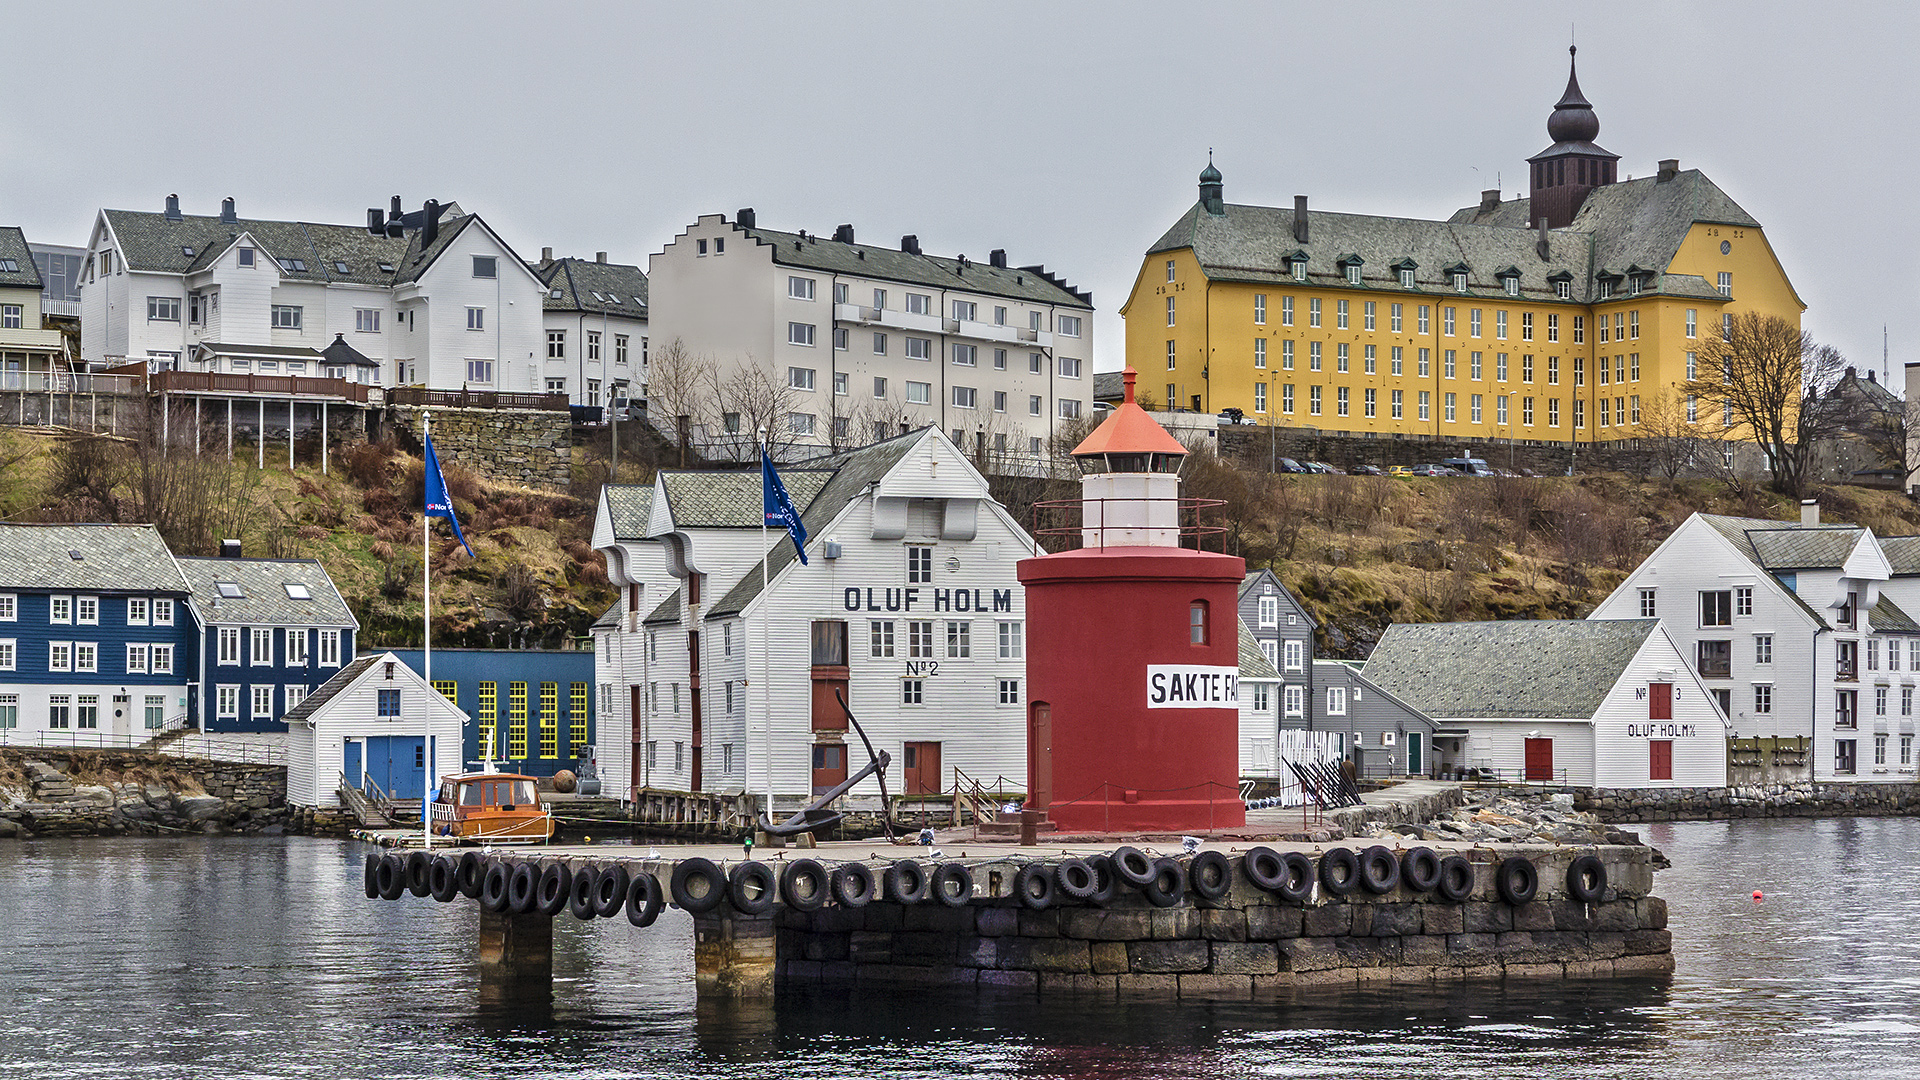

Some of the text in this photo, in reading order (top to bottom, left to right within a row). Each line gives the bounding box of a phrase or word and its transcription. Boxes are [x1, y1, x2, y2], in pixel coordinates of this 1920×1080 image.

[844, 587, 1011, 613] OLUF HOLM
[1151, 673, 1220, 703] SAKTE
[1628, 724, 1656, 737] OLUF
[1660, 724, 1689, 737] HOLM
